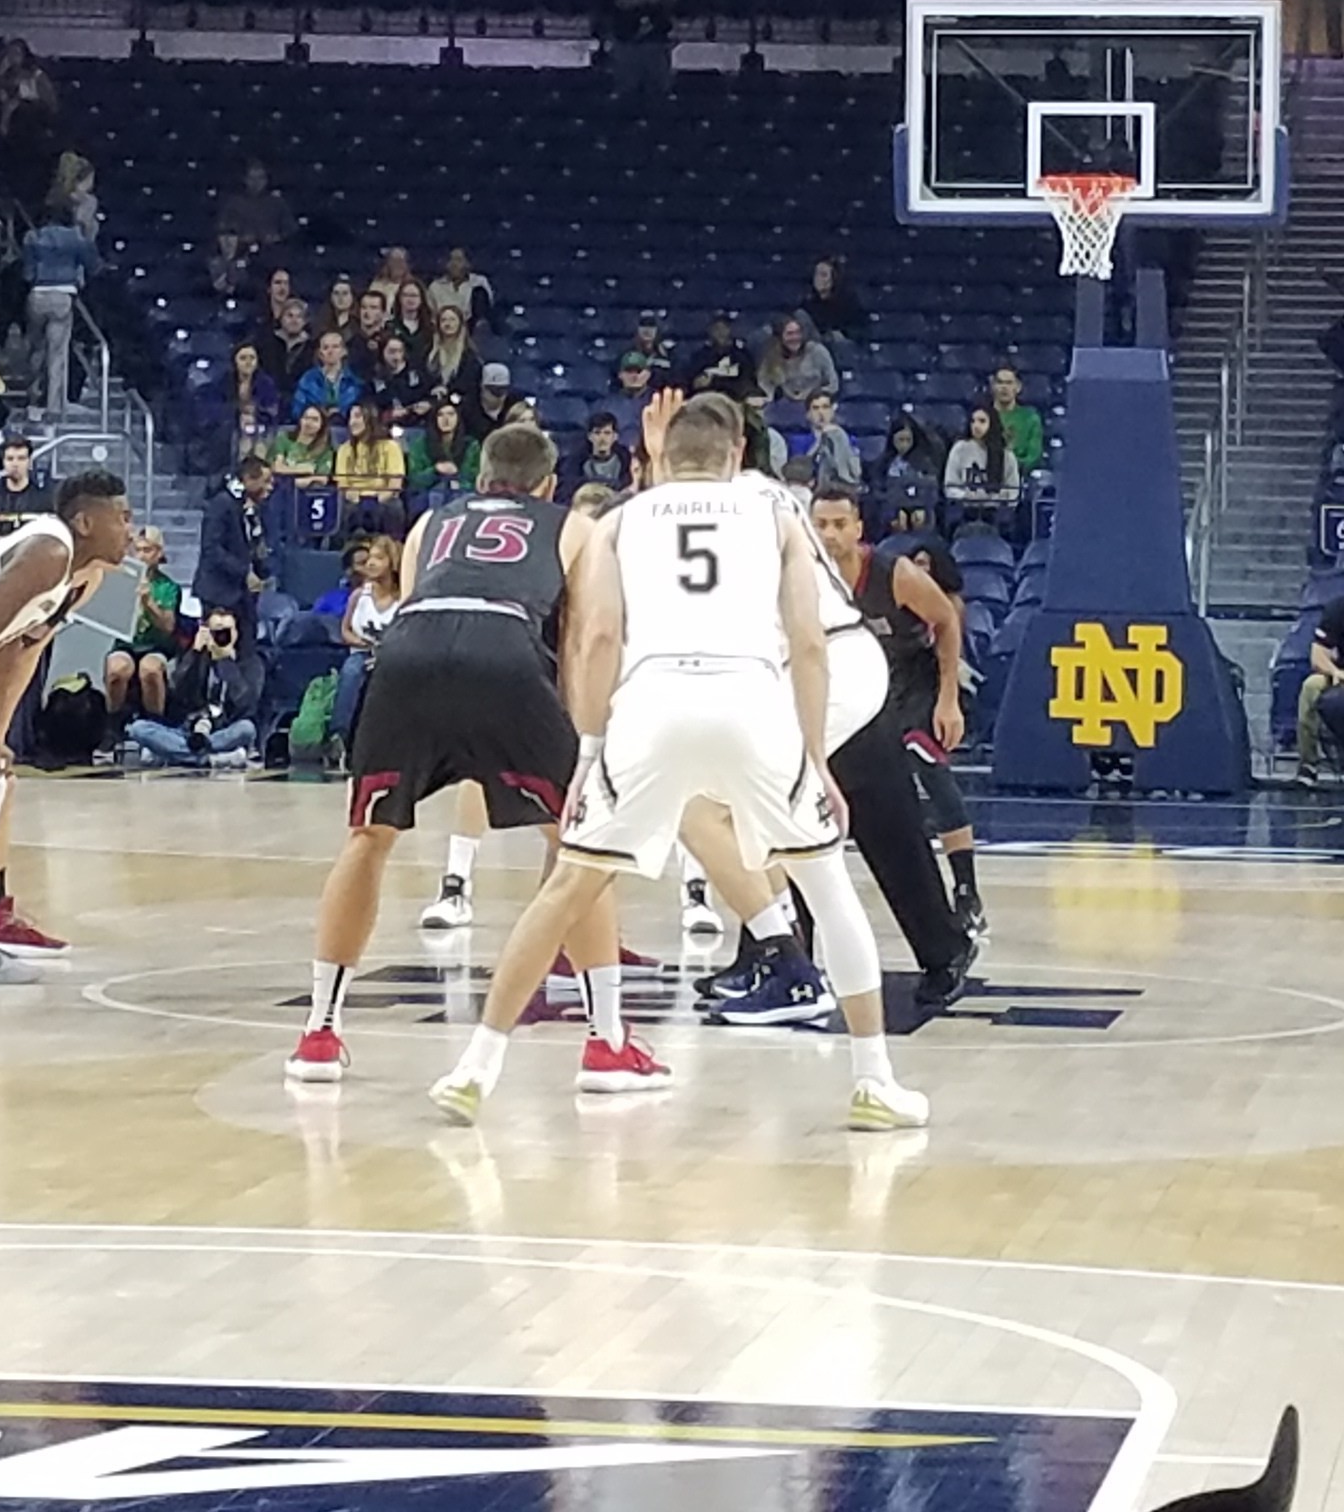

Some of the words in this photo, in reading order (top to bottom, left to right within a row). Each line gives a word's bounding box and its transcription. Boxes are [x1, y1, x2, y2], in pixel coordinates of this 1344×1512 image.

[311, 498, 325, 520] 5
[427, 516, 534, 570] 15
[676, 522, 720, 594] 5
